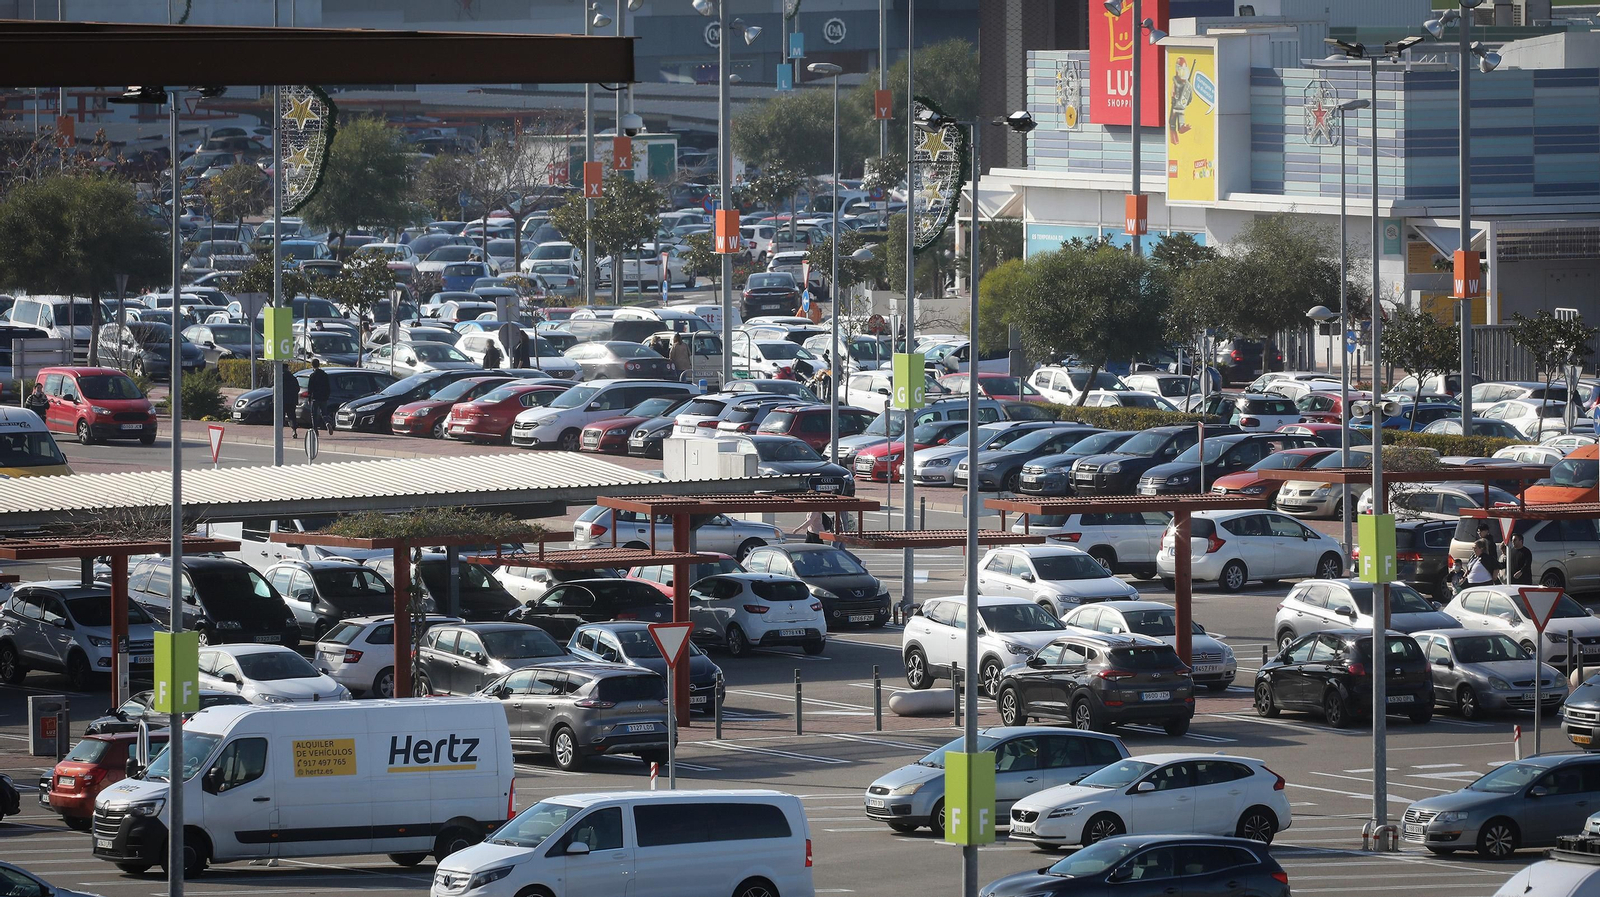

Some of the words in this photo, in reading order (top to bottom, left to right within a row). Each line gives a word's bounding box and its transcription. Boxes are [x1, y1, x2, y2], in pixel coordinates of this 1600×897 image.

[793, 48, 801, 56] M
[782, 80, 788, 88] L
[880, 107, 888, 117] Y
[62, 135, 70, 146] X
[619, 156, 627, 167] X
[590, 184, 598, 194] X
[1126, 218, 1136, 231] W
[1140, 218, 1146, 231] W
[716, 236, 724, 249] W
[728, 236, 738, 249] W
[1455, 279, 1464, 294] W
[1468, 279, 1478, 294] W
[266, 338, 272, 354] G
[280, 338, 290, 354] G
[896, 386, 906, 402] G
[914, 386, 922, 402] G
[1364, 556, 1371, 575] F
[1384, 555, 1392, 575] F
[160, 681, 166, 704] F
[182, 681, 192, 704] F
[296, 740, 334, 749] ALQUILER
[309, 748, 352, 756] VEHÍCULOS
[389, 735, 480, 764] Hertz
[952, 808, 960, 834] F
[980, 808, 989, 835] F
